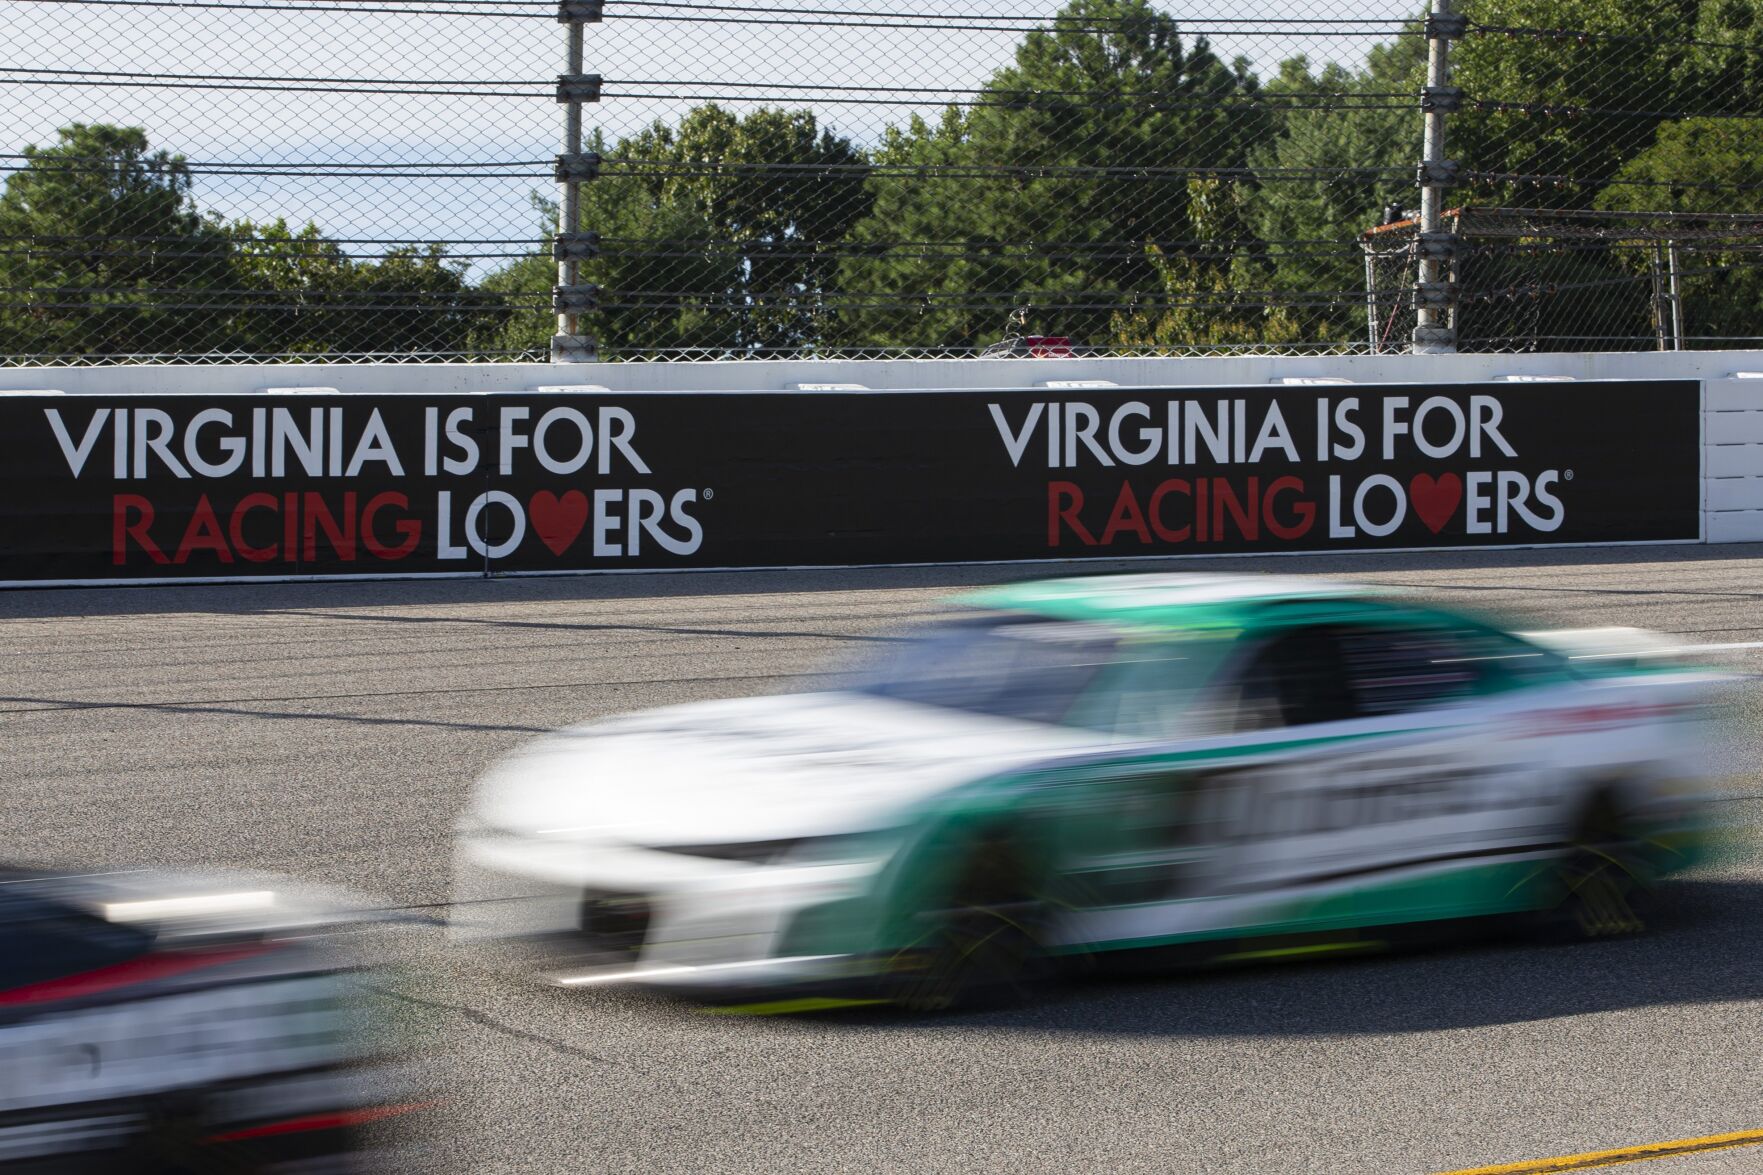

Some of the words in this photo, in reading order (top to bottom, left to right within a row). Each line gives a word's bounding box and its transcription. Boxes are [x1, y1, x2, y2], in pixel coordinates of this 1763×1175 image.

[43, 407, 406, 479] VIRGINIA
[424, 406, 480, 476] IS
[499, 406, 653, 476] FOR
[987, 398, 1301, 468] VIRGINIA
[1317, 397, 1366, 462] IS
[1382, 395, 1519, 460] FOR
[113, 490, 421, 565] RACING
[1048, 476, 1316, 546] RACING
